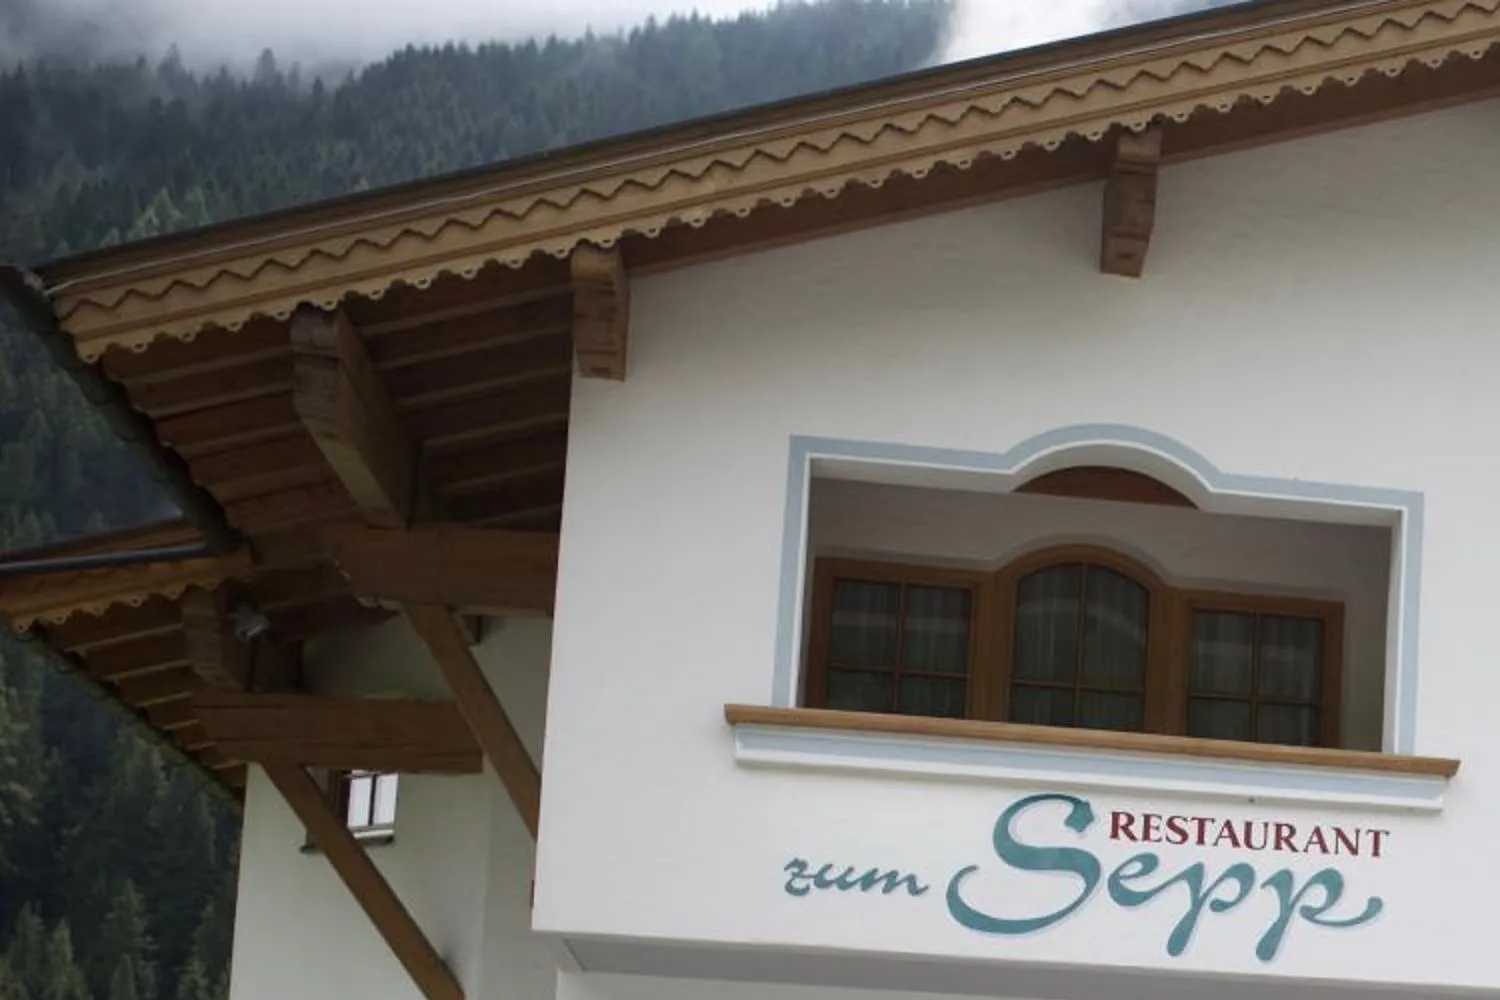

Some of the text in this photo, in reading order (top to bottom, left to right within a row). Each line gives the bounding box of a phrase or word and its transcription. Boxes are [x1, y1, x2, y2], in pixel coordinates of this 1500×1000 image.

[783, 793, 1384, 964] zum Sepp
[1109, 810, 1390, 858] RESTAURANT
